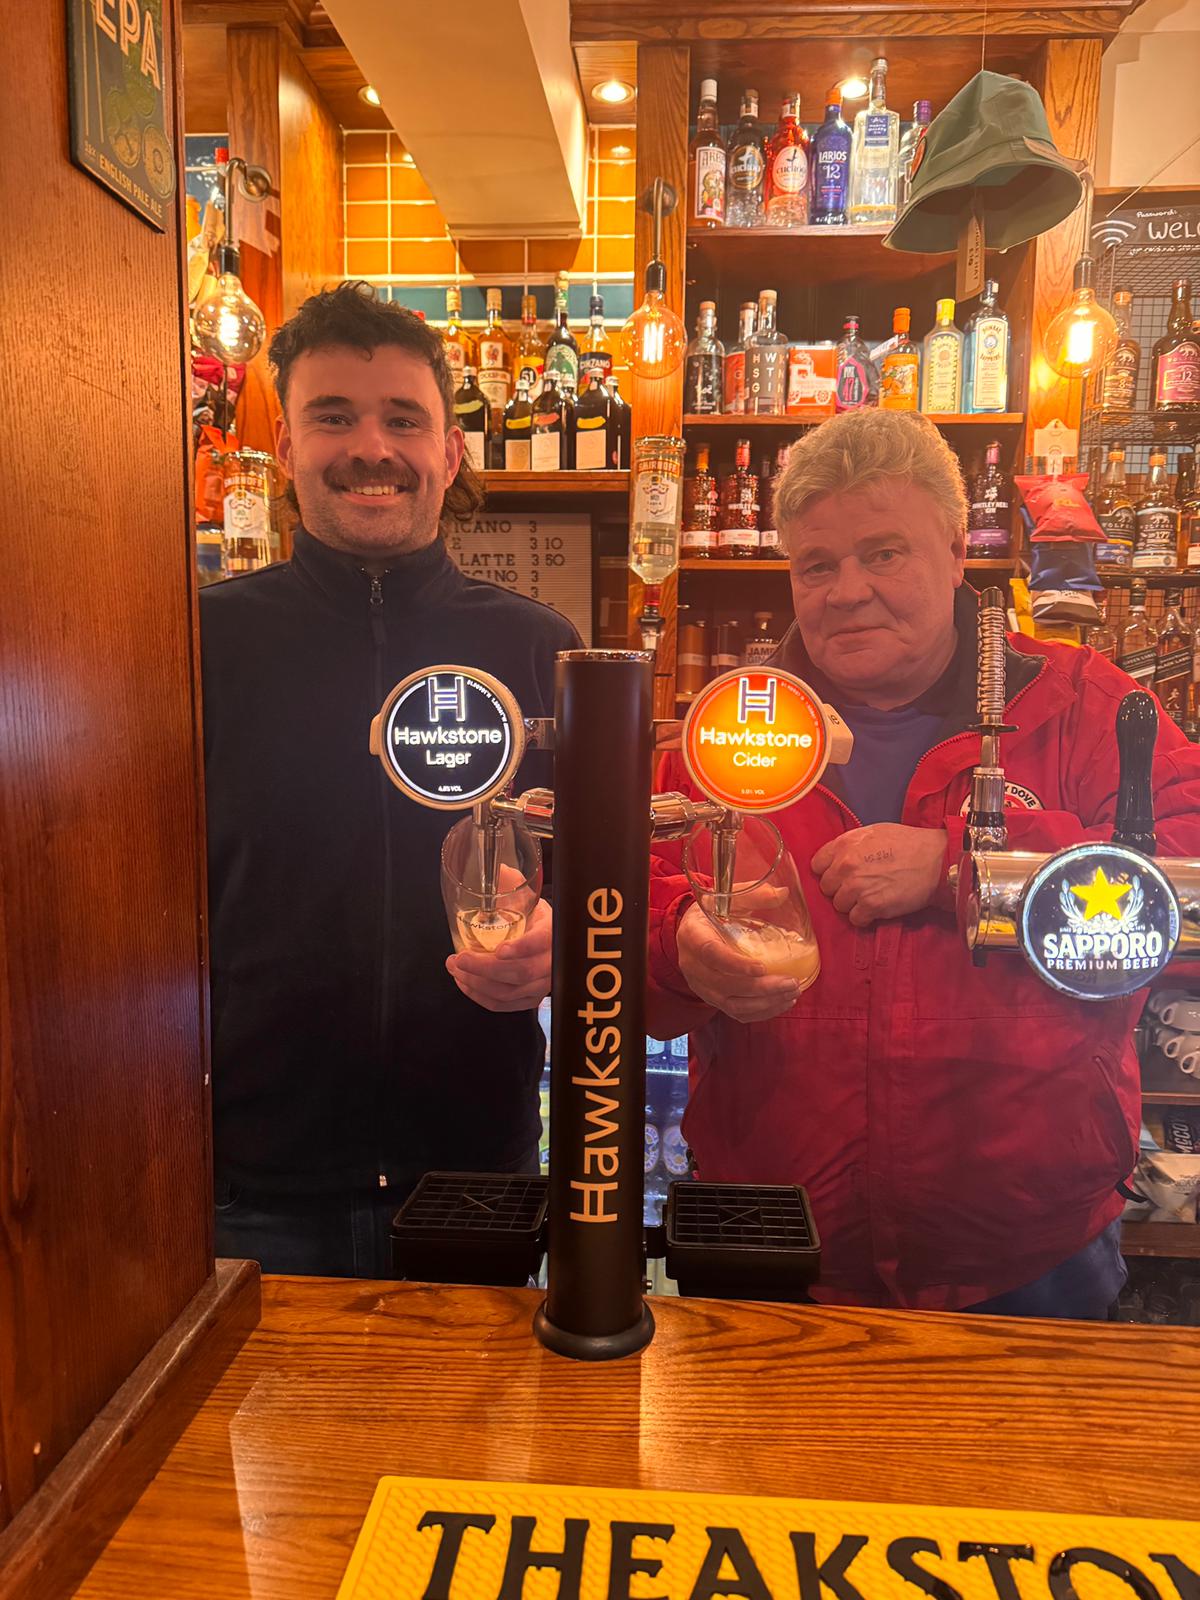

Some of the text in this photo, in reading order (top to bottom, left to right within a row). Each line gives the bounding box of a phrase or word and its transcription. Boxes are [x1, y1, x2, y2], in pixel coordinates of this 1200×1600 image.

[819, 151, 847, 163] LARIOS
[823, 164, 840, 179] 12
[100, 154, 162, 218] ENGLISH PALE ALE
[529, 520, 537, 533] 3
[530, 537, 538, 550] 3
[545, 537, 563, 550] 10
[460, 554, 565, 566] LATTE 3 50
[531, 570, 539, 583] 3
[531, 587, 538, 598] 3
[394, 726, 502, 745] Hawkstone
[700, 727, 813, 748] Hawkstone
[426, 750, 471, 768] Lager
[733, 751, 777, 767] Cider
[1011, 786, 1037, 808] DOVE
[1043, 931, 1162, 960] SAPPORO
[1047, 958, 1158, 970] PREMIUM BEER
[570, 887, 623, 1223] Hawkstone
